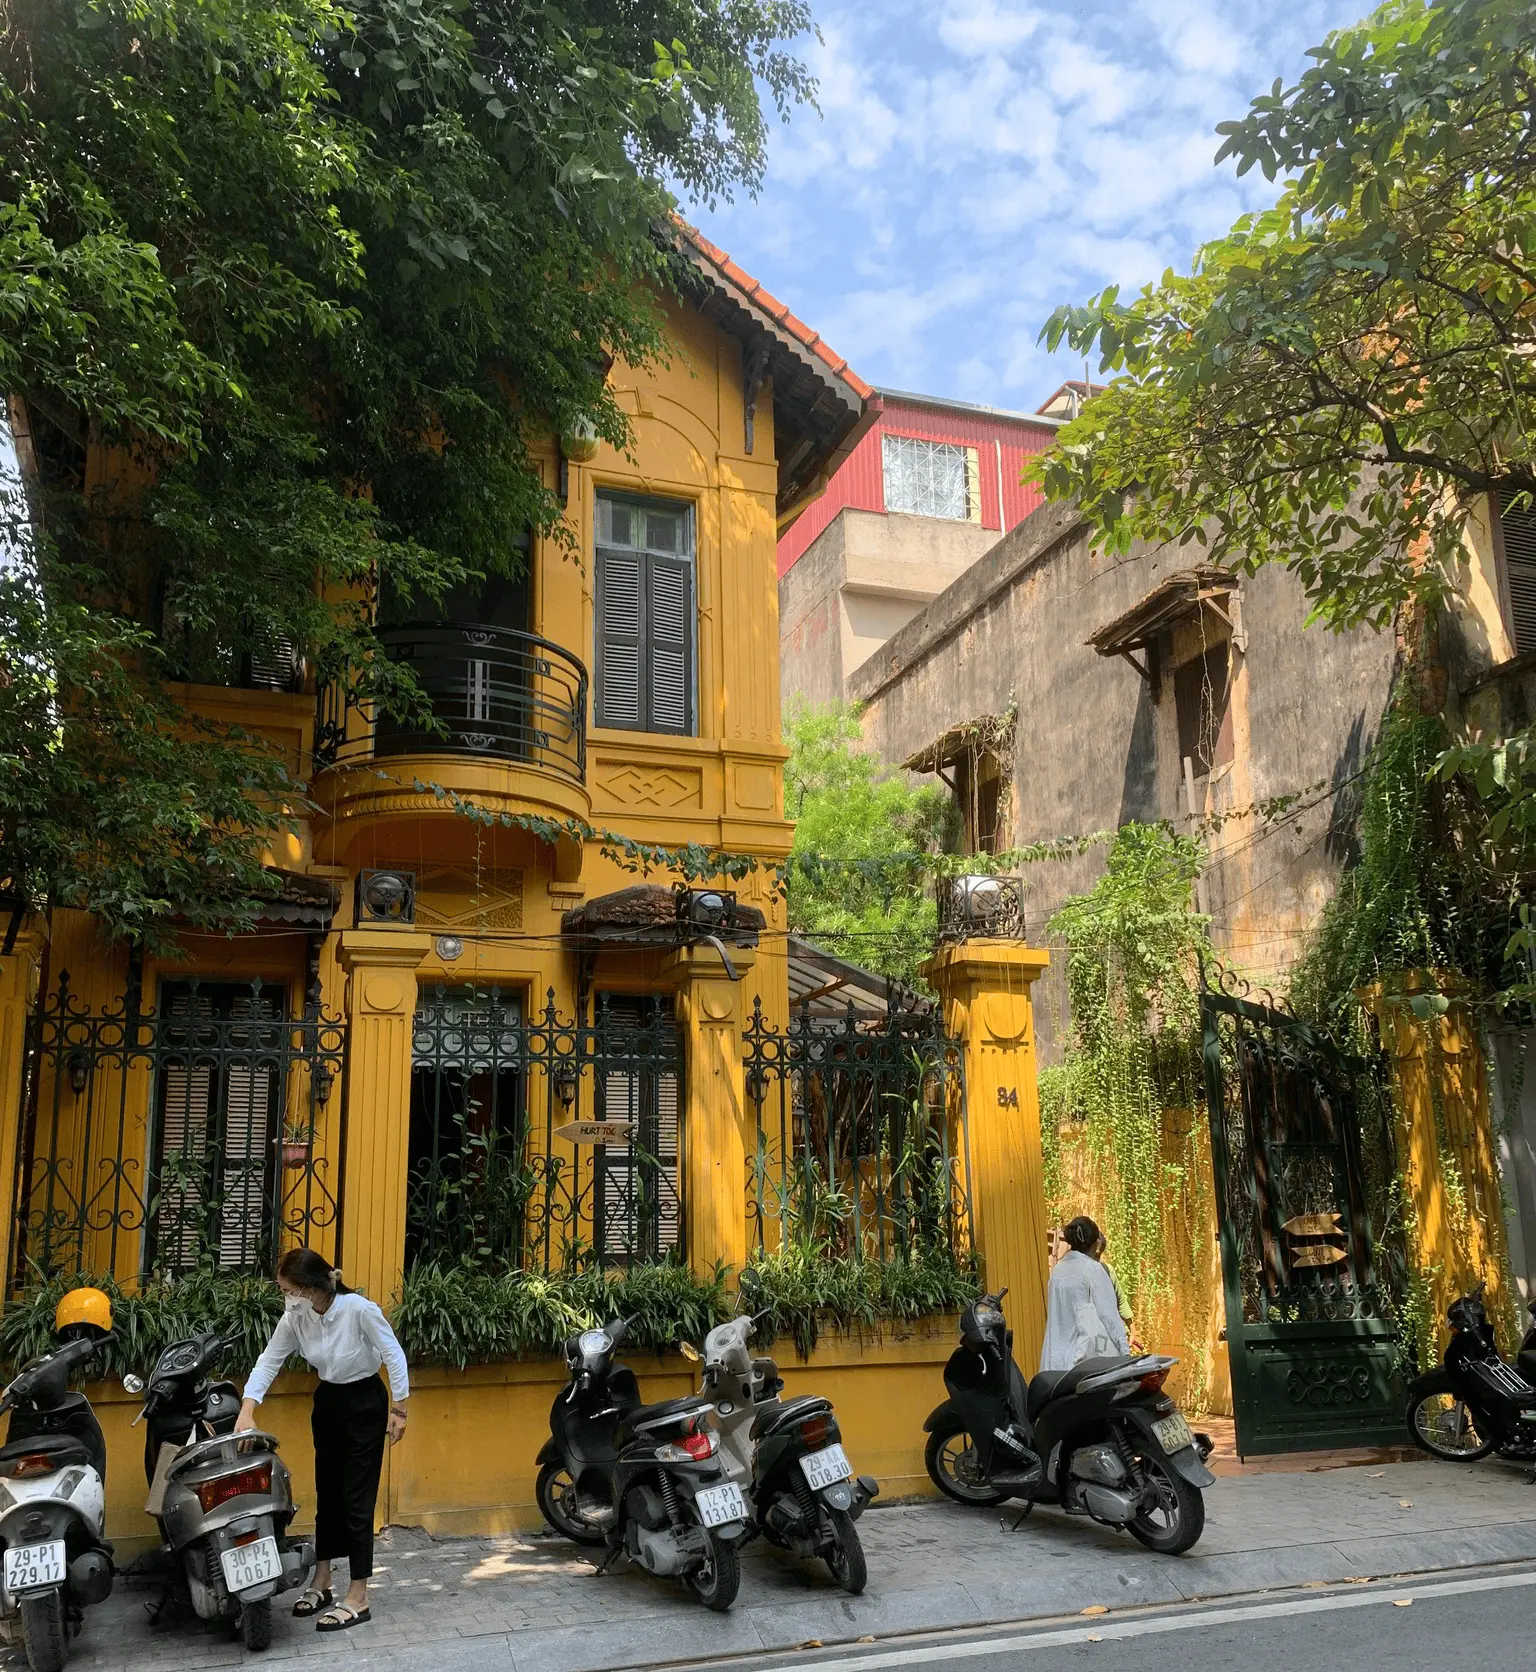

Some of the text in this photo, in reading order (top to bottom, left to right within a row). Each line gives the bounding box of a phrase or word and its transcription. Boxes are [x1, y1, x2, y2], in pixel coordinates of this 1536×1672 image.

[1157, 1416, 1183, 1438] 29-B1
[806, 1448, 840, 1472] 29-AA
[809, 1461, 850, 1488] 018.30
[704, 1486, 736, 1508] 12-P1
[705, 1500, 743, 1525] 131.87
[14, 1544, 55, 1568] 29-P1
[230, 1542, 270, 1569] 30-P4
[9, 1562, 60, 1588] 229.17
[235, 1559, 271, 1586] 4067
